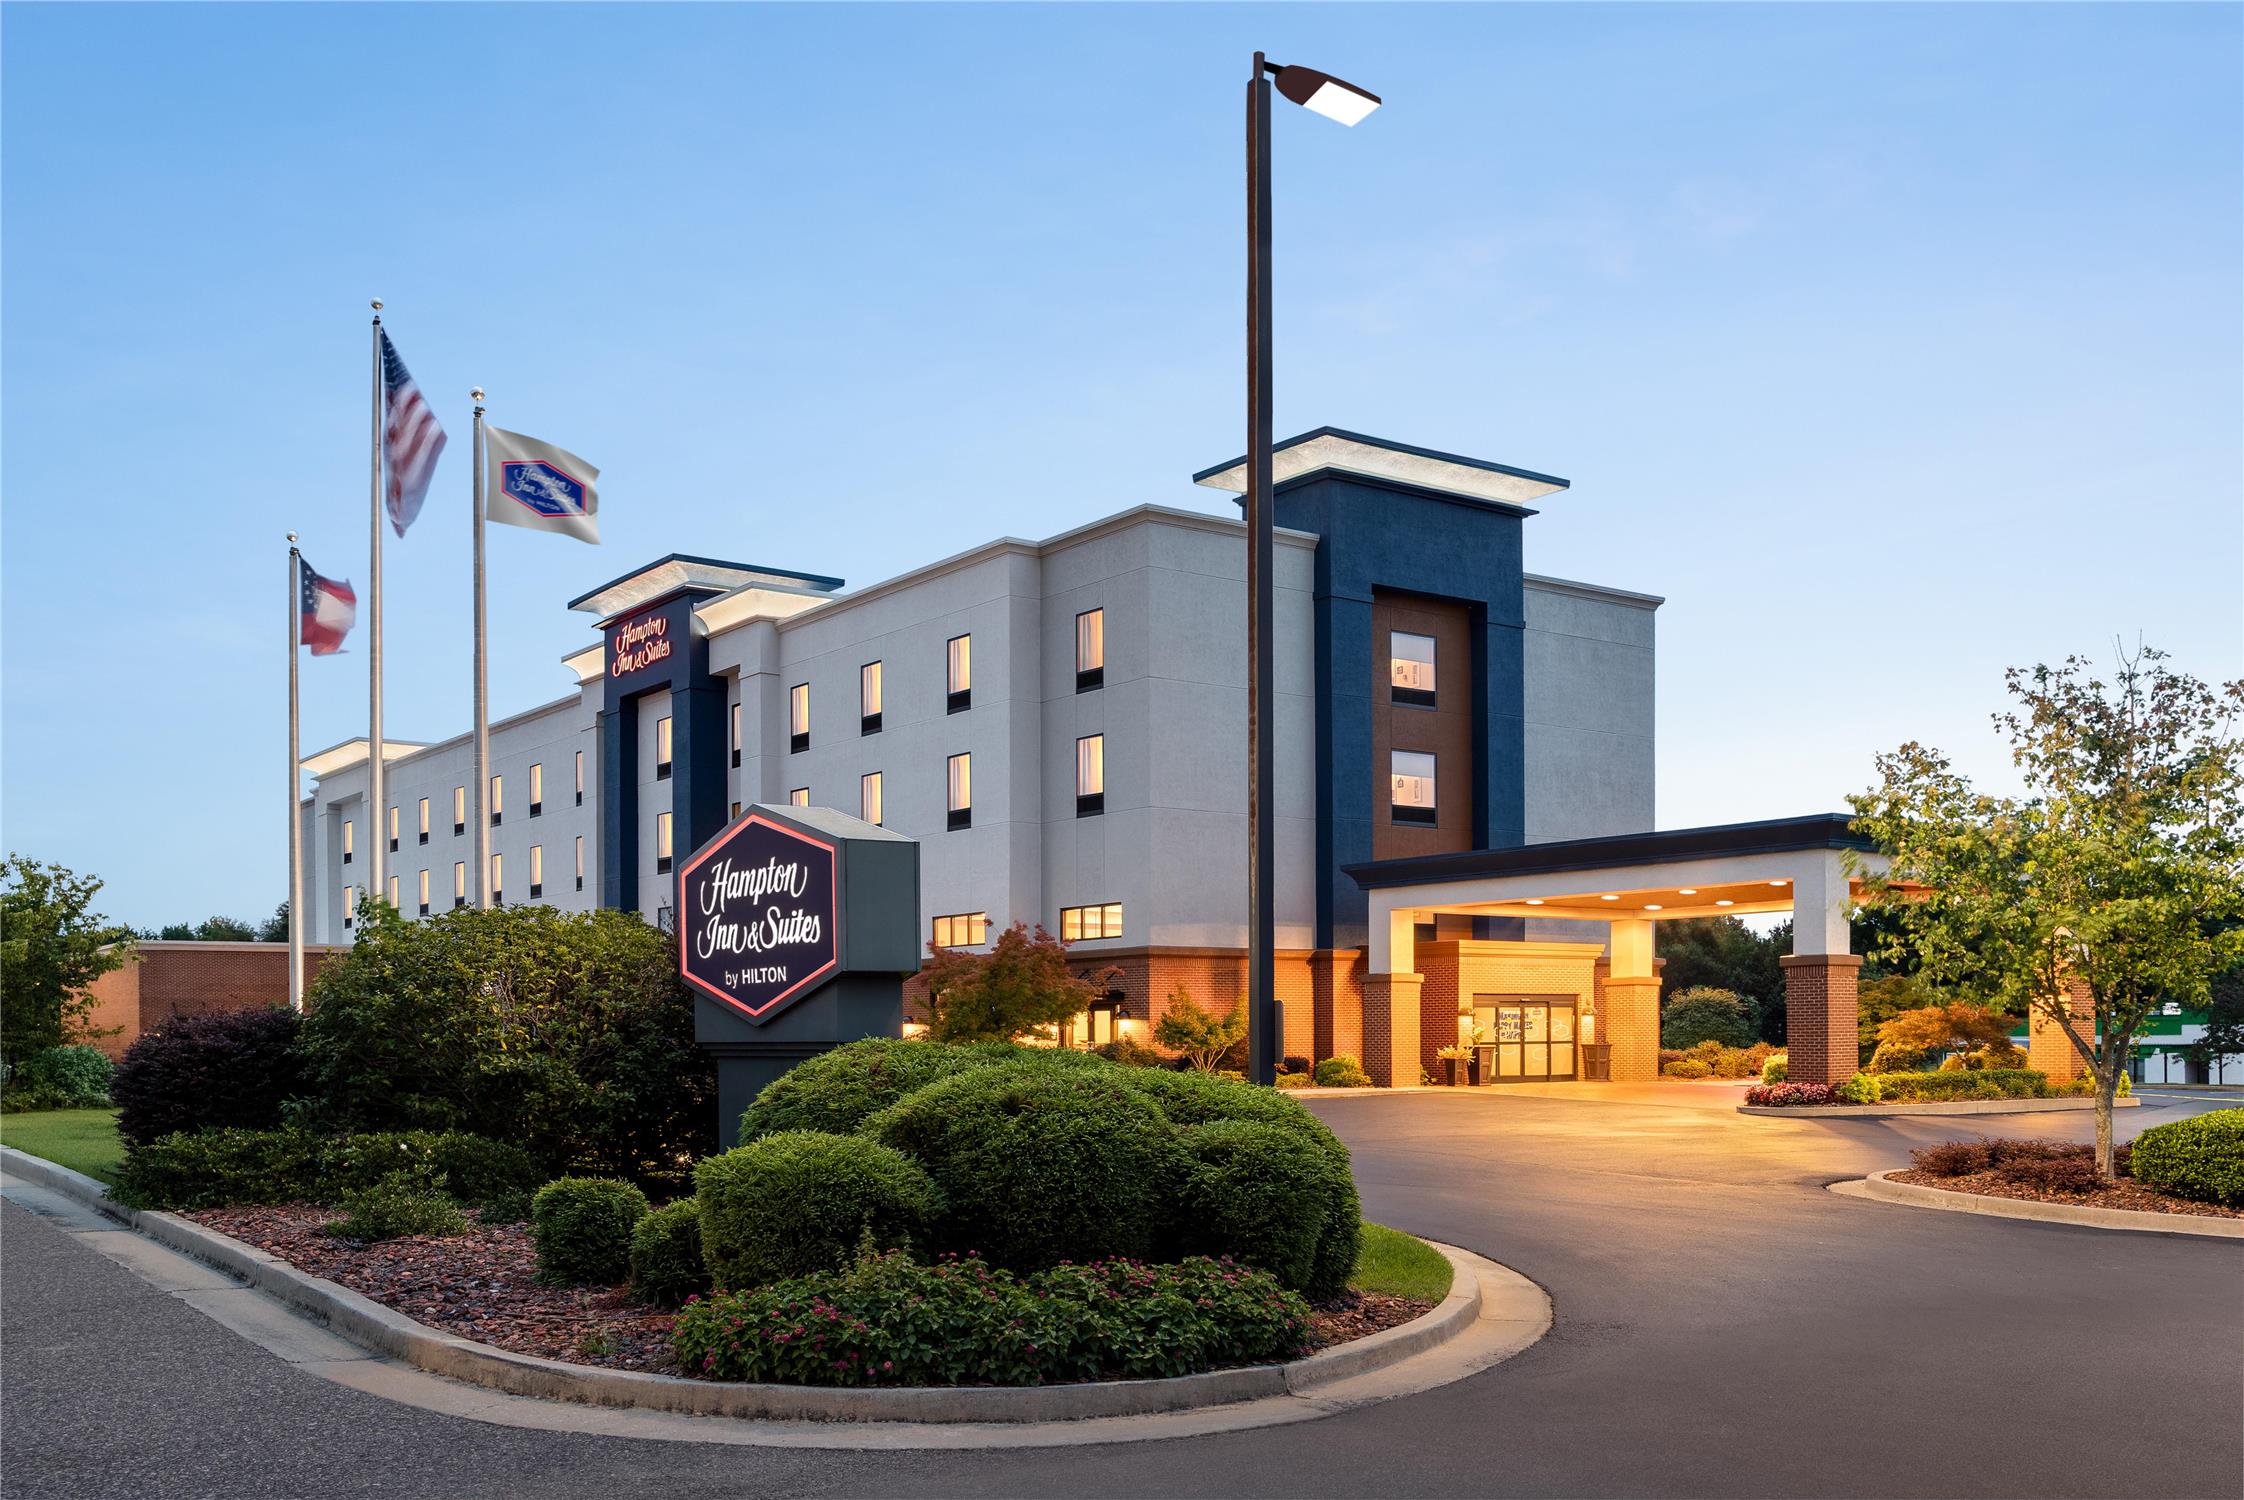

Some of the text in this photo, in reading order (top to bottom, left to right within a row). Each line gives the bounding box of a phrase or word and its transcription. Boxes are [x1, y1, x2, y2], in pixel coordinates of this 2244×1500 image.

[616, 616, 667, 654] Hampton
[612, 639, 670, 677] Inn & Suites
[700, 856, 808, 916] Hampton
[697, 906, 821, 959] Inn & Suites
[725, 966, 787, 989] by HILTON
